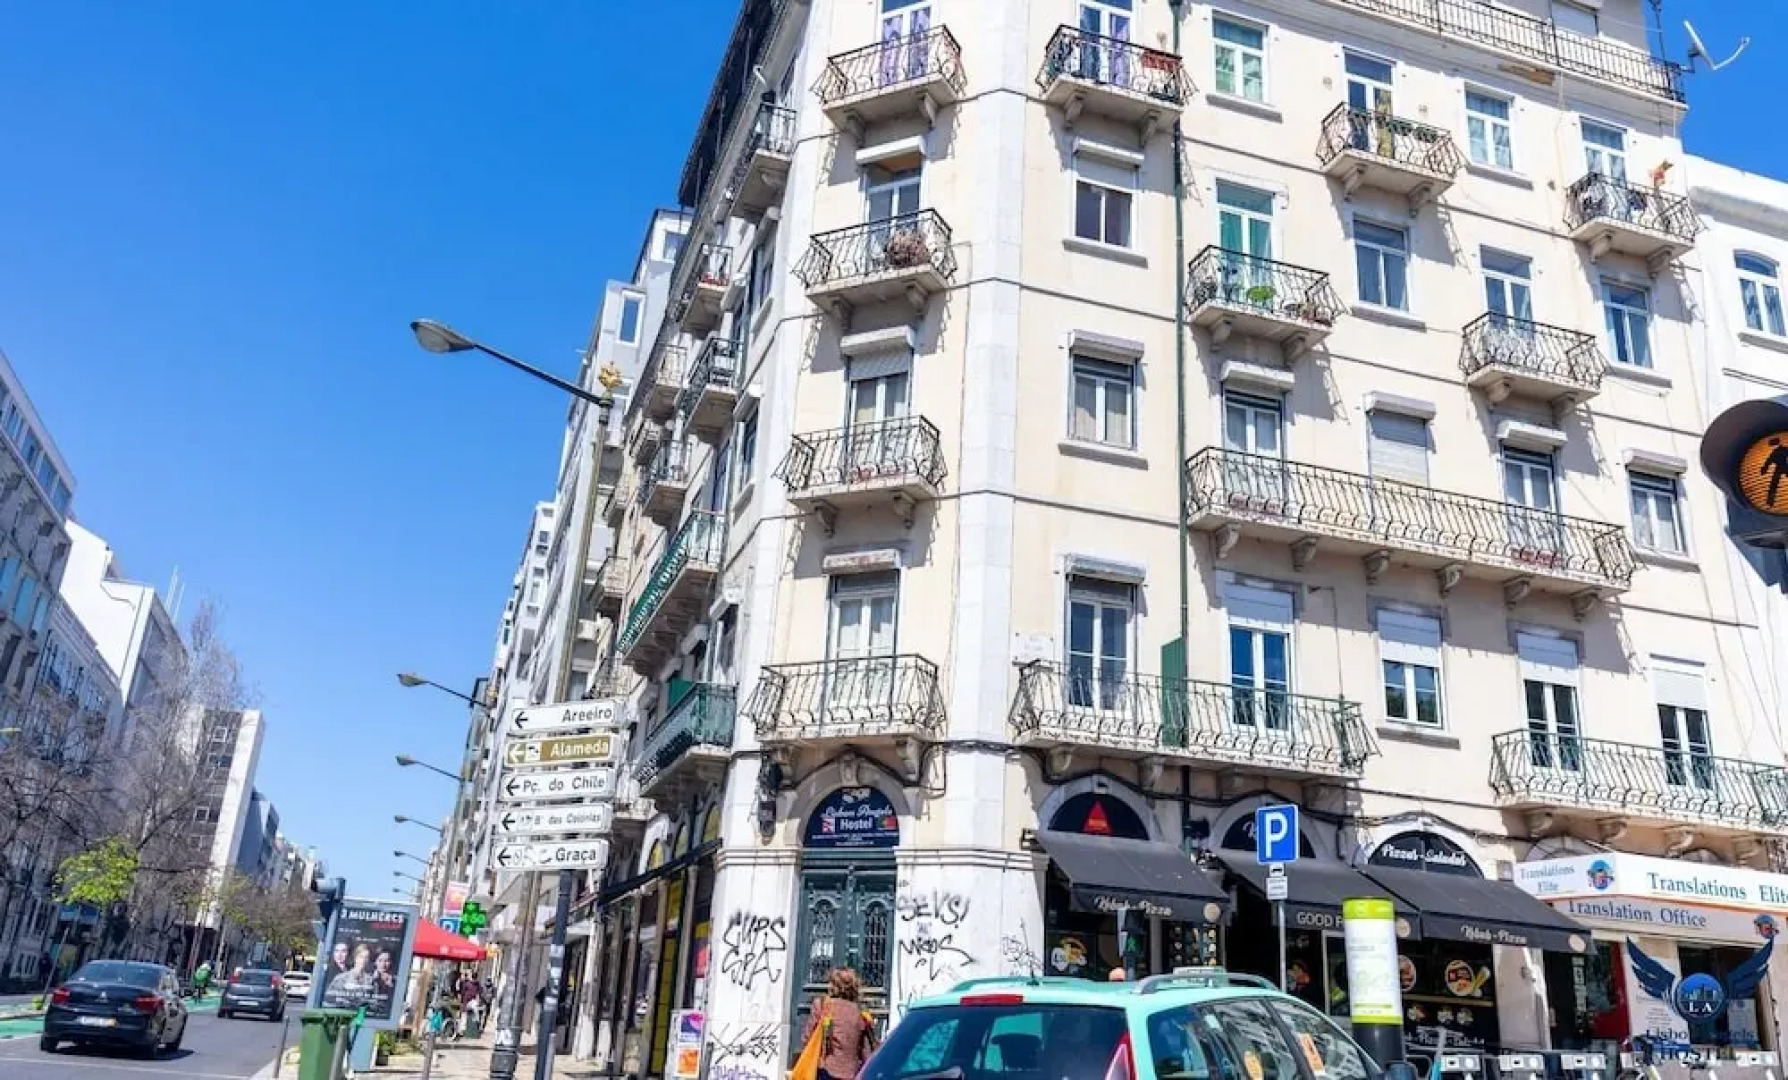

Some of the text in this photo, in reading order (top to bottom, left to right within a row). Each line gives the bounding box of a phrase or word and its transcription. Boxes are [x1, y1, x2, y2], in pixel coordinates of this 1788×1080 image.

[562, 706, 613, 723] Areeiro
[550, 739, 609, 757] Alameda
[549, 777, 564, 791] do
[572, 775, 605, 790] Chile
[840, 817, 873, 830] Hostel
[1265, 811, 1288, 859] P
[555, 847, 596, 864] Graça
[1521, 864, 1574, 879] Translations
[1647, 872, 1788, 903] Translations Elit
[1297, 911, 1333, 927] GOOD
[1569, 900, 1707, 928] Translation Office
